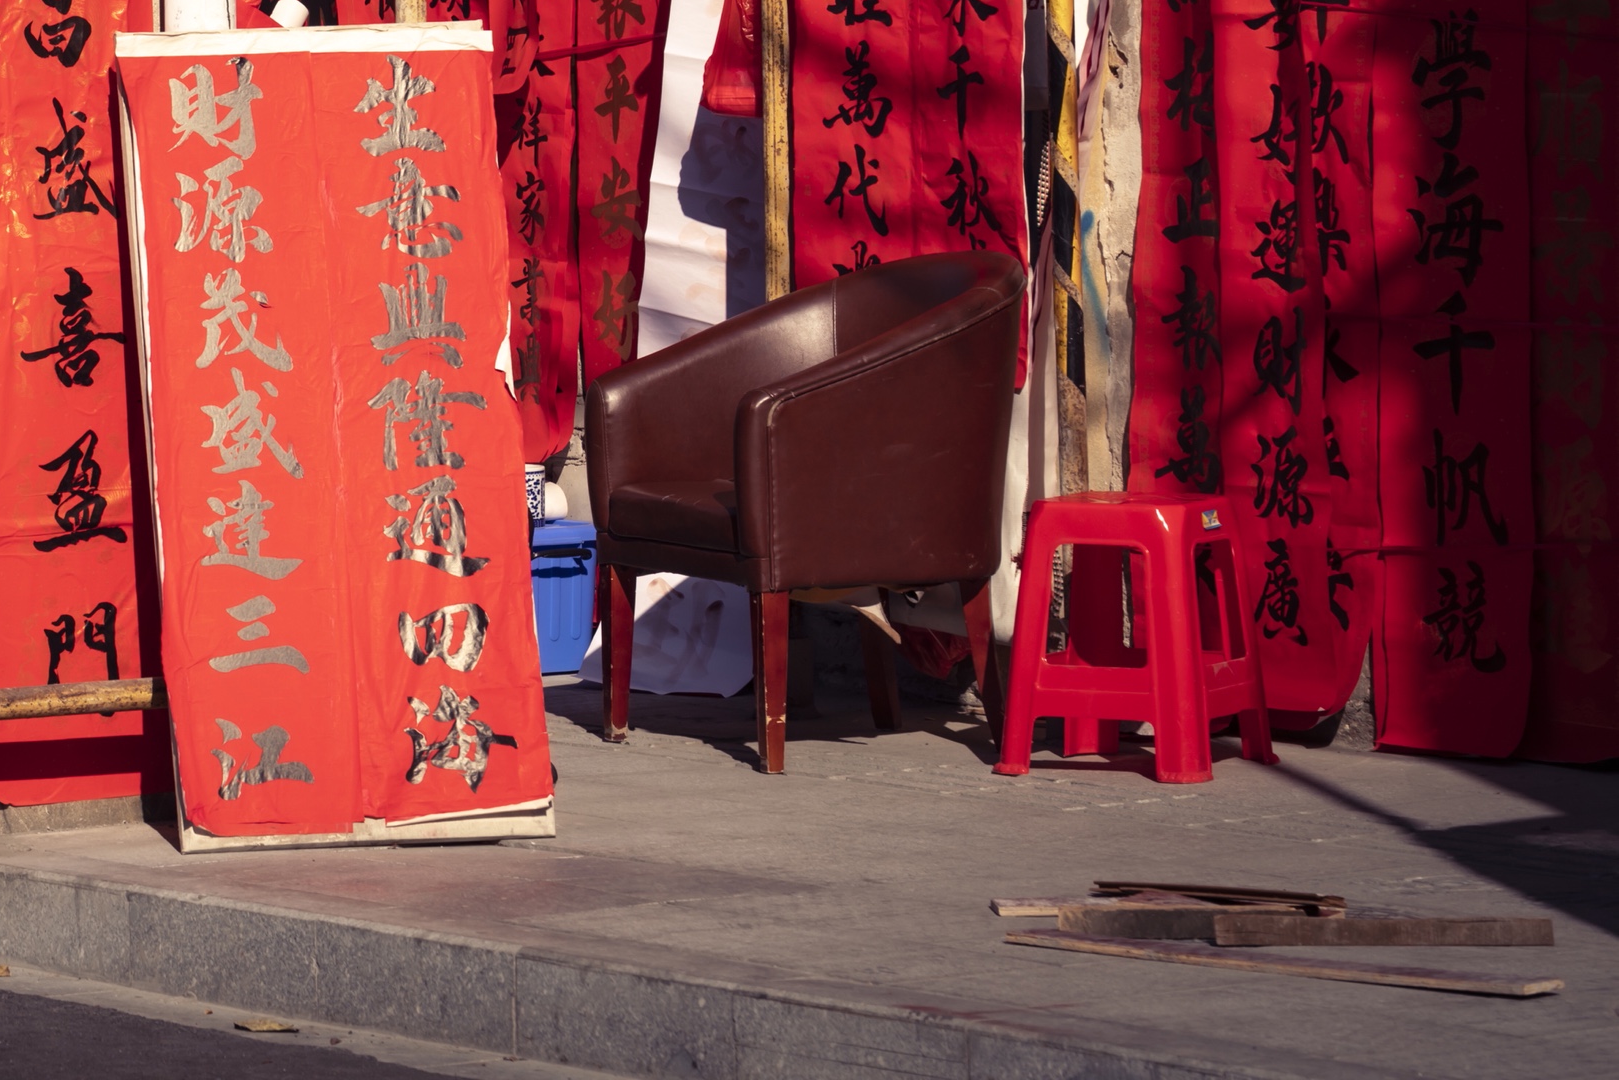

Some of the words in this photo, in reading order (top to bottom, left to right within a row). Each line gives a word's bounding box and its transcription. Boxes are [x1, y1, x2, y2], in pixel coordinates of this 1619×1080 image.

[169, 56, 313, 800] 財源茂盛達三江
[353, 54, 519, 794] 生意興隆通四海
